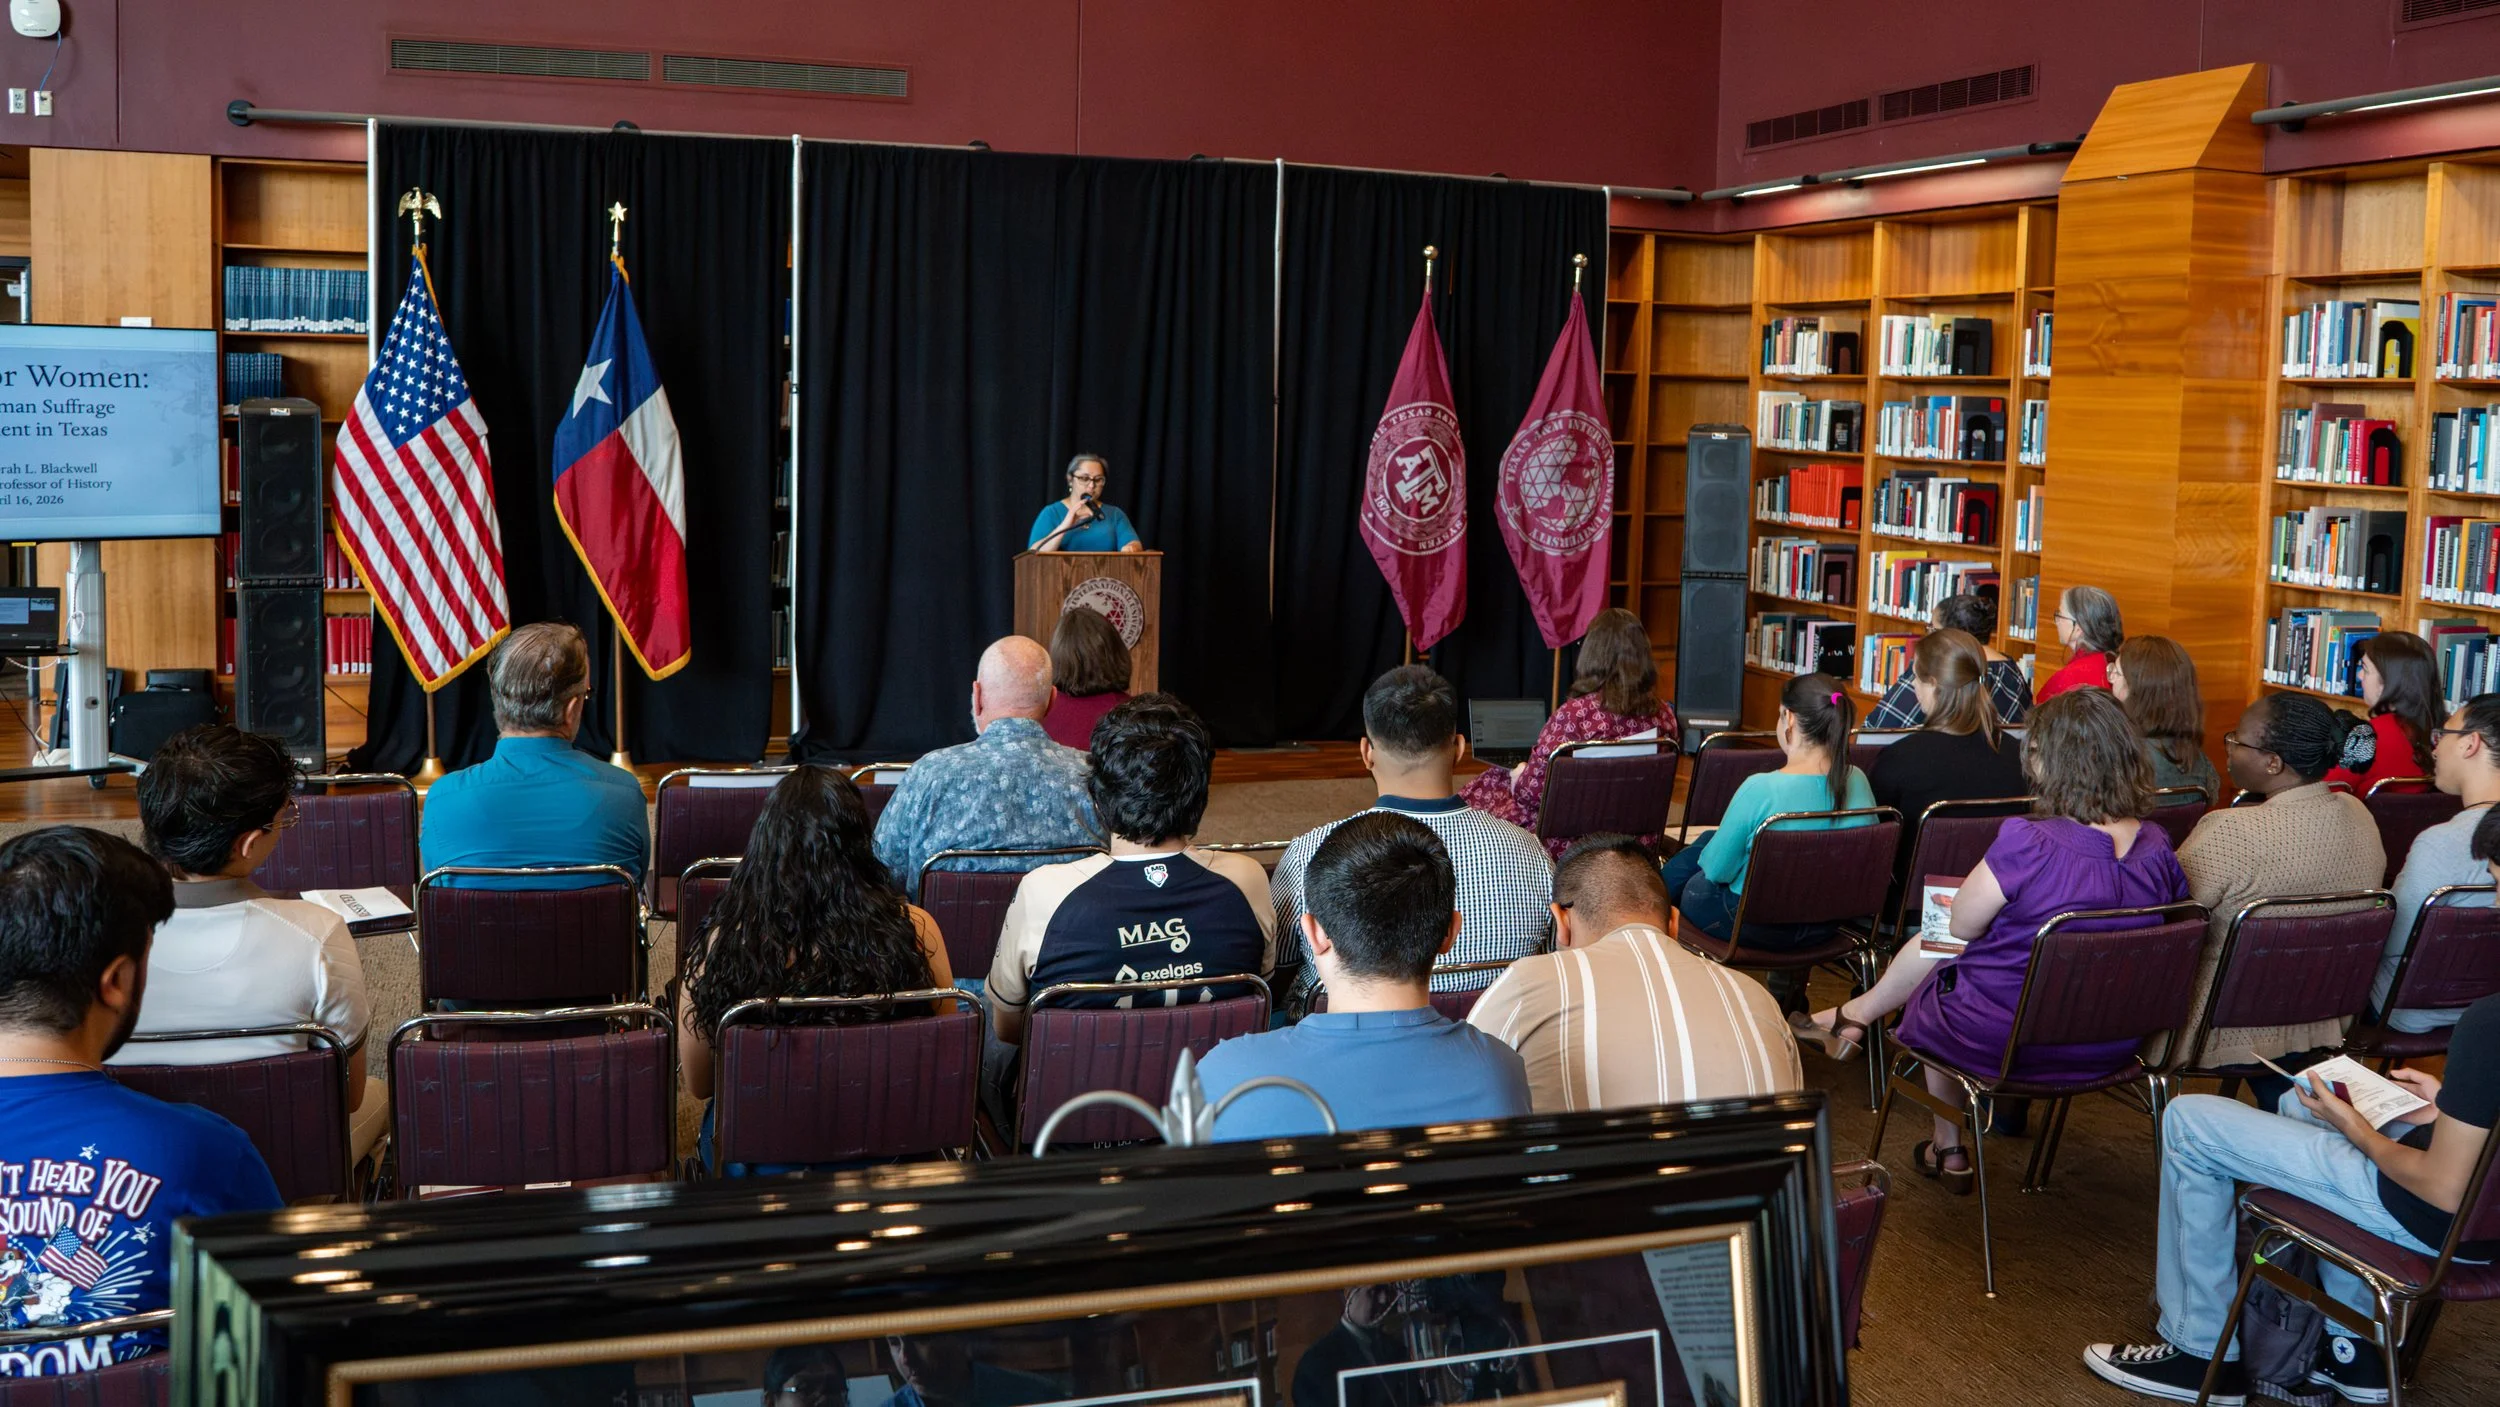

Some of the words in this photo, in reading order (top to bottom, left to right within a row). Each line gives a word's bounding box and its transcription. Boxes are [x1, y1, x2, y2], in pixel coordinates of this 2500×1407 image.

[25, 364, 149, 389] Women:
[42, 398, 116, 419] Suffrage
[1389, 407, 1432, 425] TEXAS
[1, 424, 31, 437] ent
[36, 422, 53, 437] in
[58, 421, 108, 437] Texas
[1, 462, 21, 474] rah
[25, 464, 37, 474] L.
[41, 462, 98, 474] Blackwell
[1505, 439, 1532, 485] TEXAS
[50, 478, 64, 490] of
[68, 478, 112, 492] History
[16, 495, 33, 506] 16,
[36, 495, 64, 505] 2026
[1374, 494, 1393, 518] 1876
[1071, 582, 1133, 605] INTERNATIONAL
[1117, 917, 1191, 954] MAG
[1141, 961, 1204, 981] exelgas
[0, 1161, 24, 1196] 'T
[28, 1158, 94, 1195] HEAR
[94, 1158, 162, 1219] YOU
[0, 1196, 76, 1236] SOUND
[78, 1206, 114, 1242] OF
